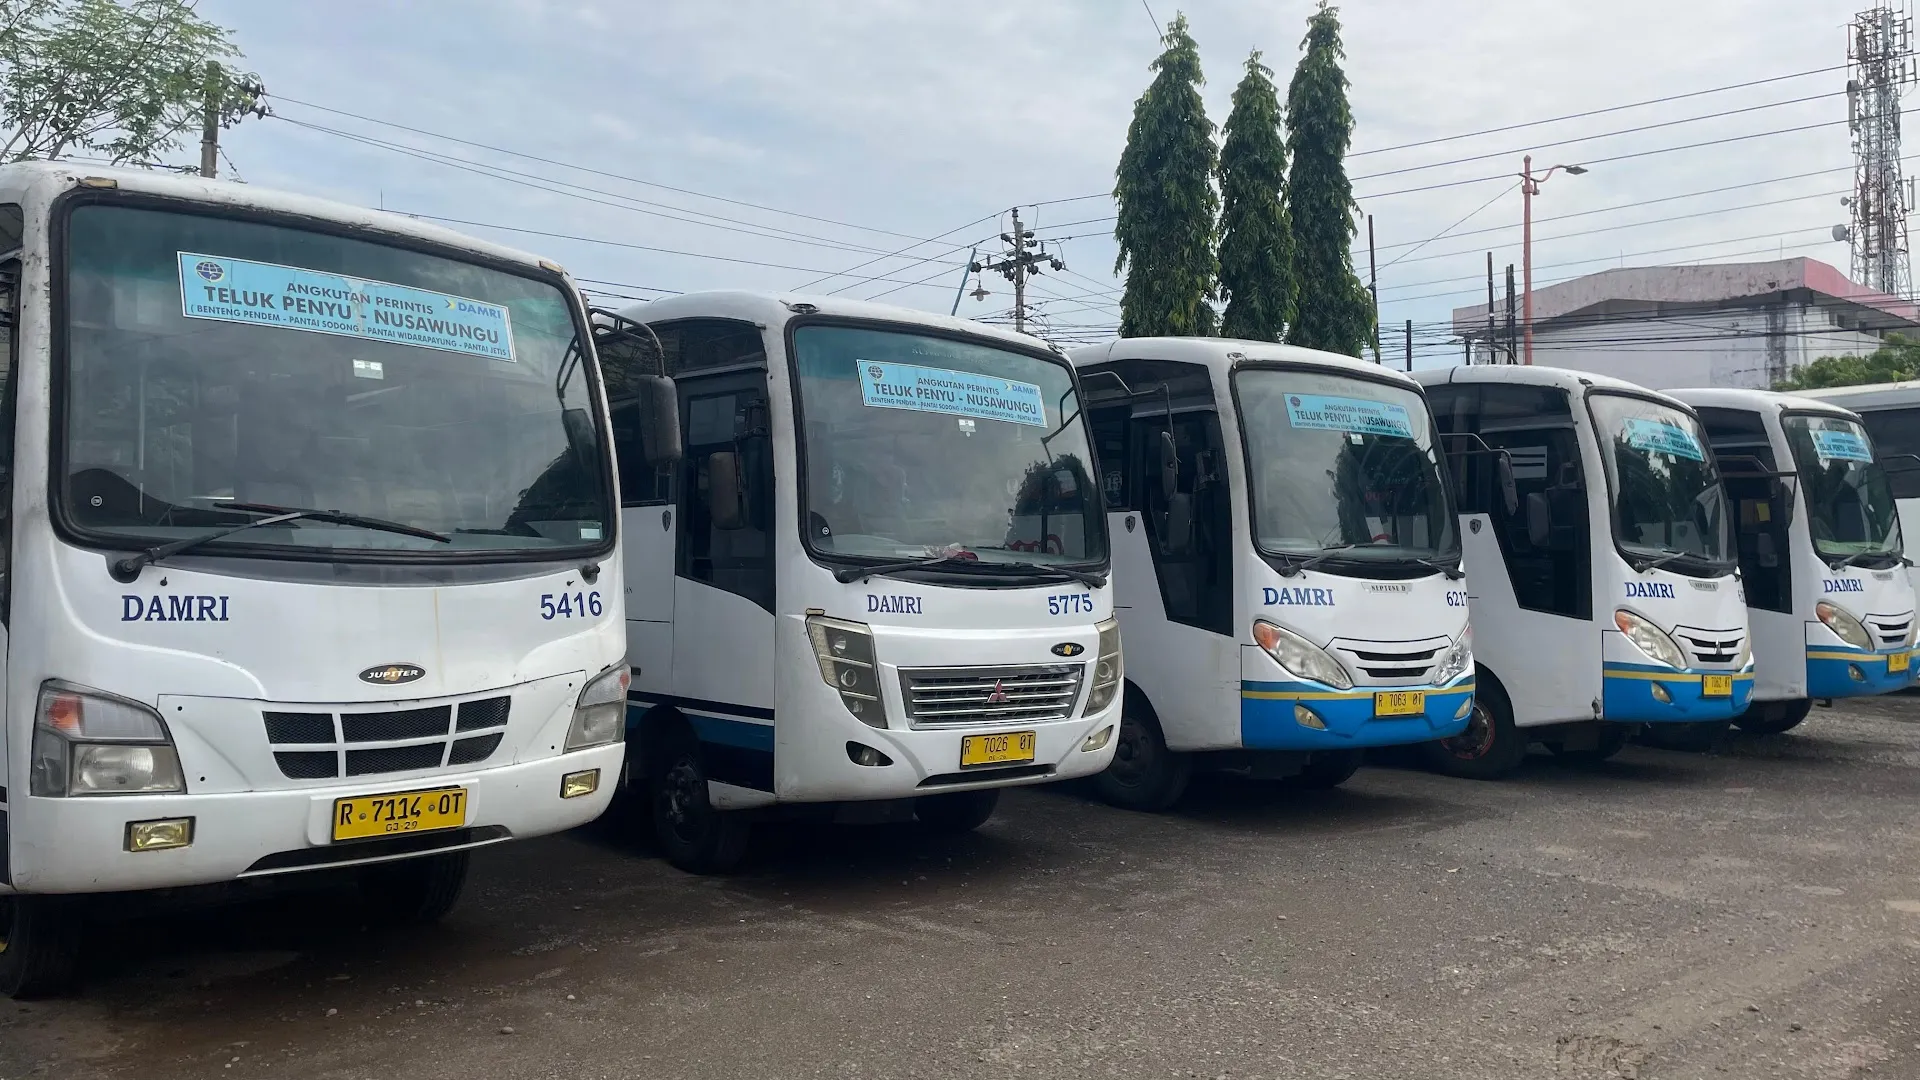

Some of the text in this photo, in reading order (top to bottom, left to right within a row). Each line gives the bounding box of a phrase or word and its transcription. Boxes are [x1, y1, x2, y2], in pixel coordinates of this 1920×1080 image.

[286, 282, 434, 314] ANGKUTAN PERINTIS
[203, 285, 276, 309] TELUK
[282, 295, 351, 320] PENYU
[374, 309, 499, 344] NUSAWUNGU
[457, 301, 501, 319] DAMRI
[197, 304, 241, 317] BENTENG
[243, 310, 280, 322] PENDEM
[289, 316, 320, 327] PANTAI
[322, 321, 359, 332] SODONG
[367, 327, 395, 337] PANTAI
[398, 332, 457, 347] WIDARAPAYUNG
[464, 342, 489, 353] PANTAI
[917, 378, 1000, 395] ANGKUTAN PERINTIS
[1011, 384, 1037, 396] DAMRI
[873, 382, 913, 398] TELUK
[916, 387, 955, 403] PENYU
[966, 393, 1037, 415] NUSAWUNGU
[1324, 404, 1357, 413] ANGKUTAN
[1295, 410, 1323, 421] TELUK
[1324, 412, 1351, 423] PENYU
[1358, 415, 1407, 430] NUSAWUNGU
[1624, 581, 1676, 599] DAMRI
[1823, 578, 1864, 593] DAMRI
[540, 591, 603, 620] 5416
[866, 594, 923, 615] DAMRI
[1047, 593, 1093, 616] 5775
[1262, 587, 1336, 606] DAMRI
[121, 595, 229, 622] DAMRI
[367, 669, 419, 679] JUPITER
[1378, 694, 1384, 708] R
[1390, 693, 1407, 707] 7063
[964, 739, 972, 755] R
[984, 736, 1009, 754] 7026
[340, 792, 463, 825] R 7114 OT
